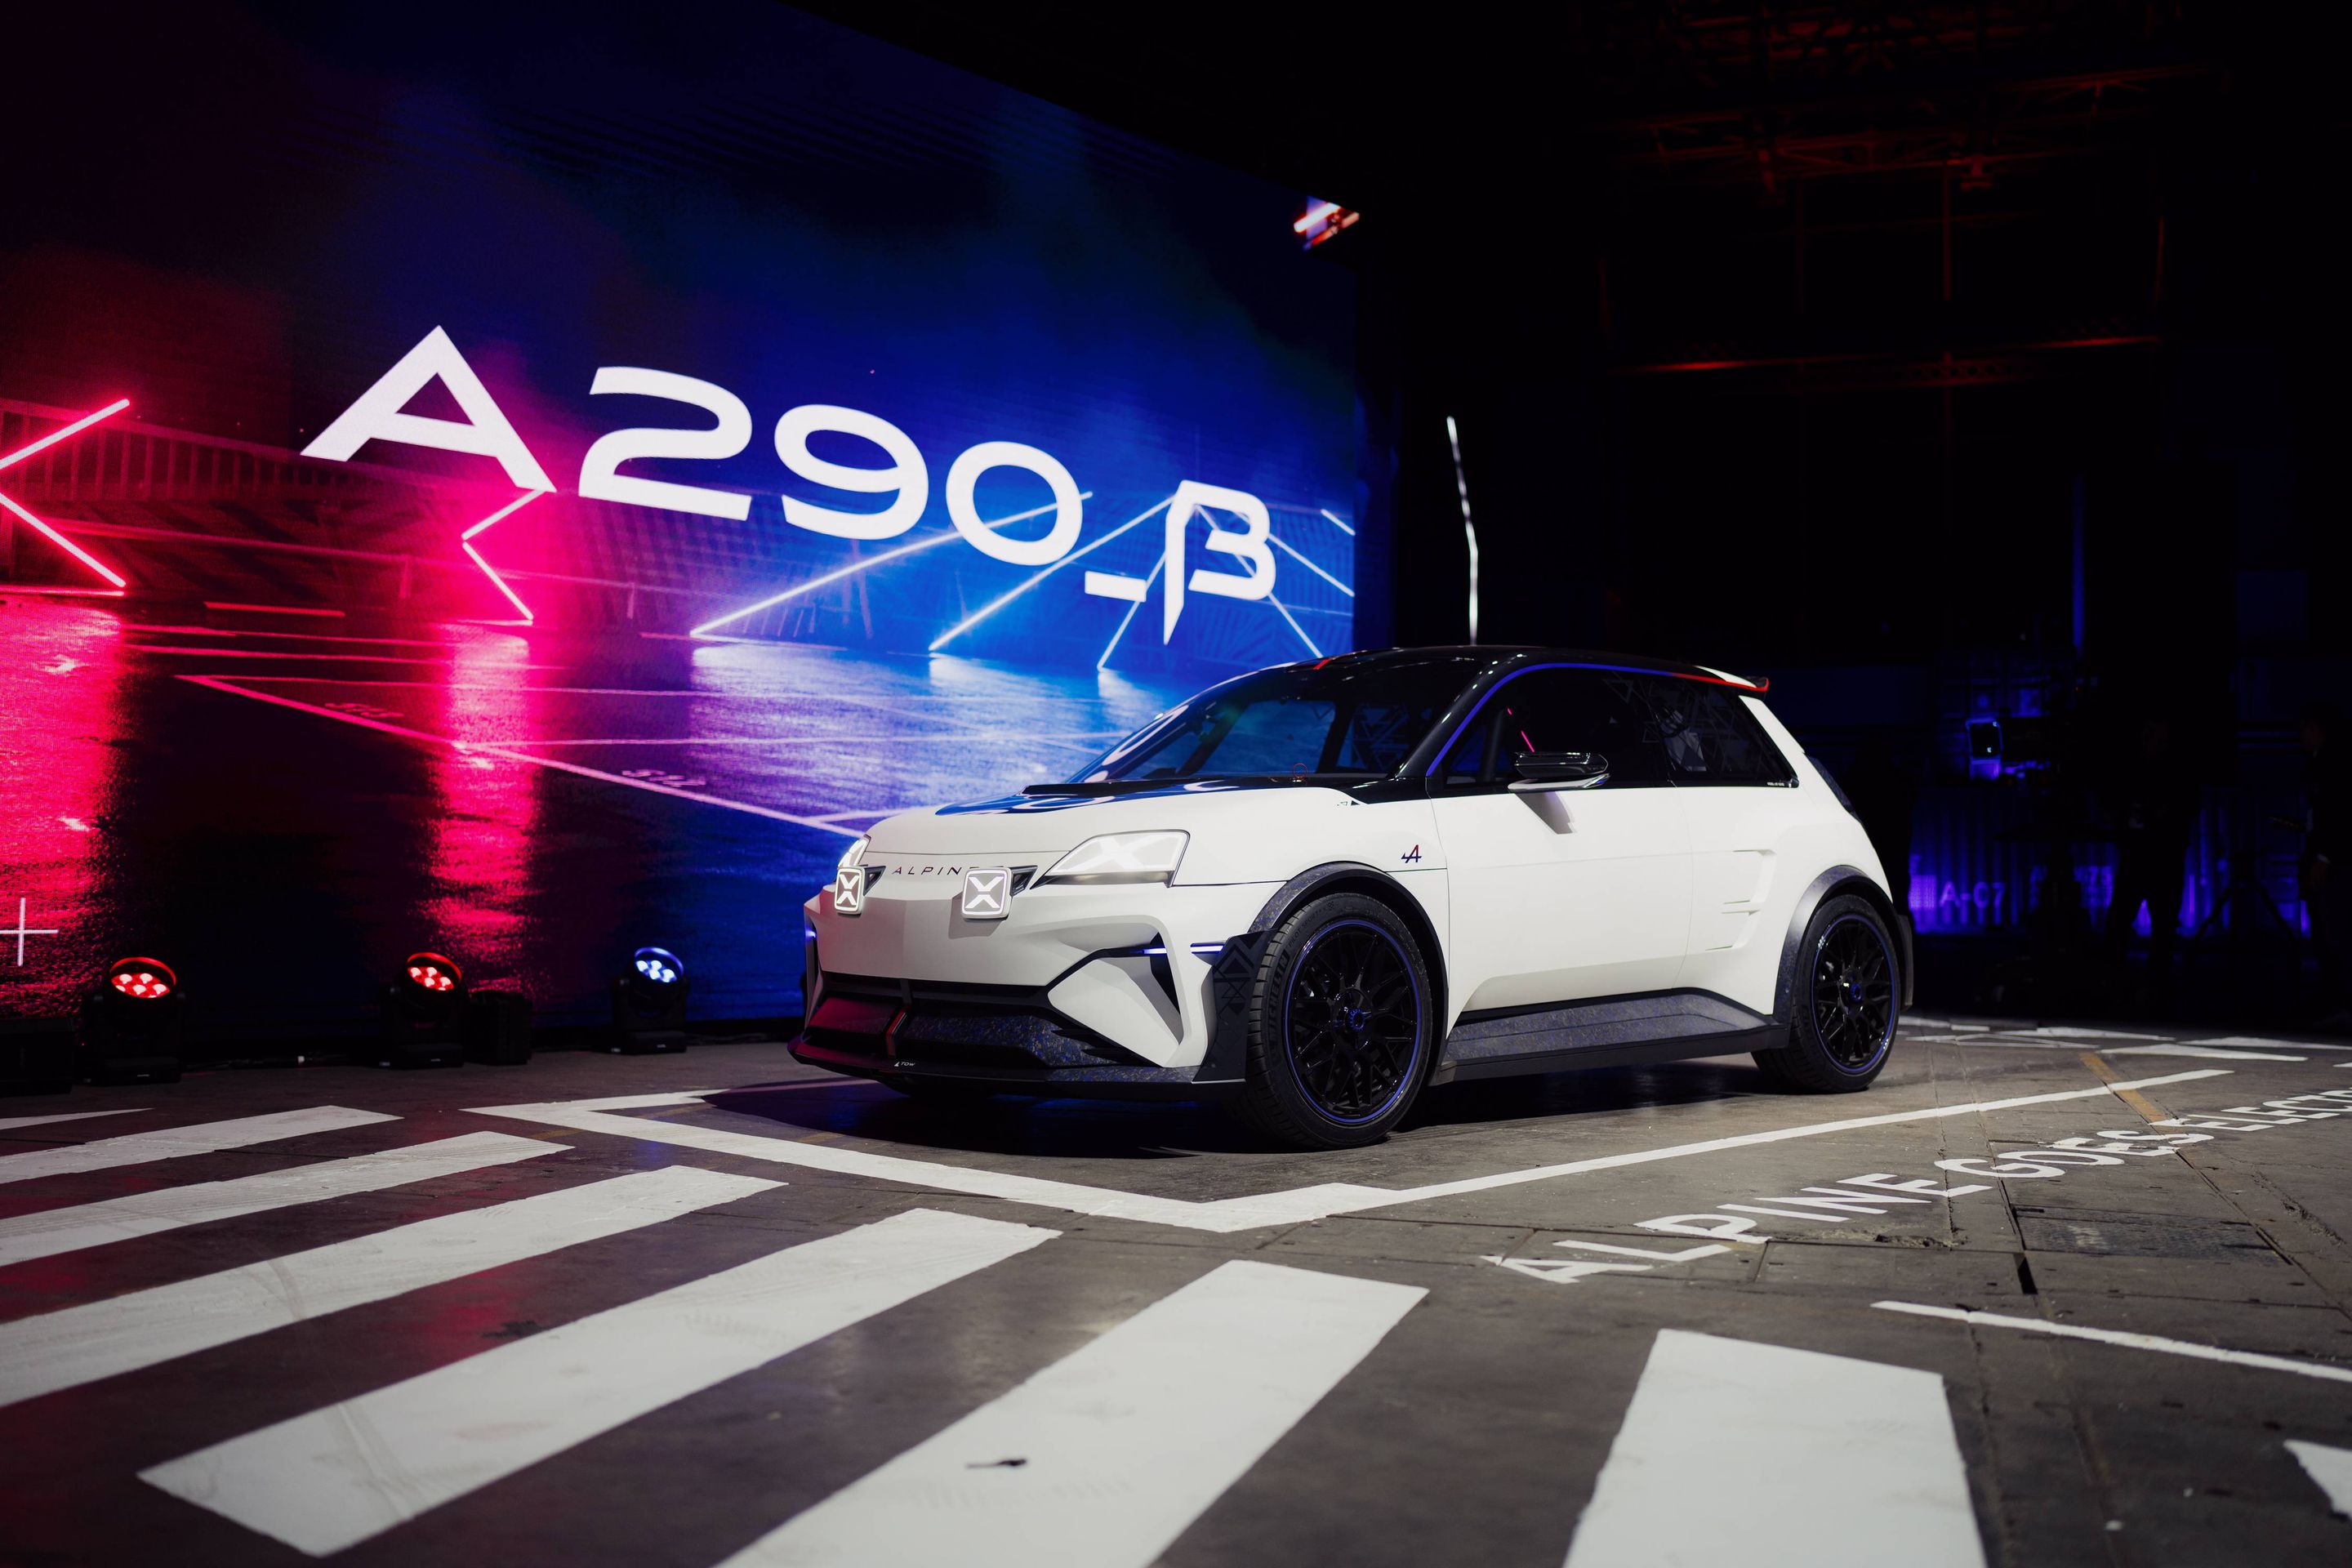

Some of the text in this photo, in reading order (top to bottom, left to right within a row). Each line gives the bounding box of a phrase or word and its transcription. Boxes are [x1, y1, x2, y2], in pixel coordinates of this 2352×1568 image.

[892, 866, 980, 875] ALPIN
[1479, 1173, 1994, 1285] ALPINE
[1933, 1129, 2215, 1178] GOES
